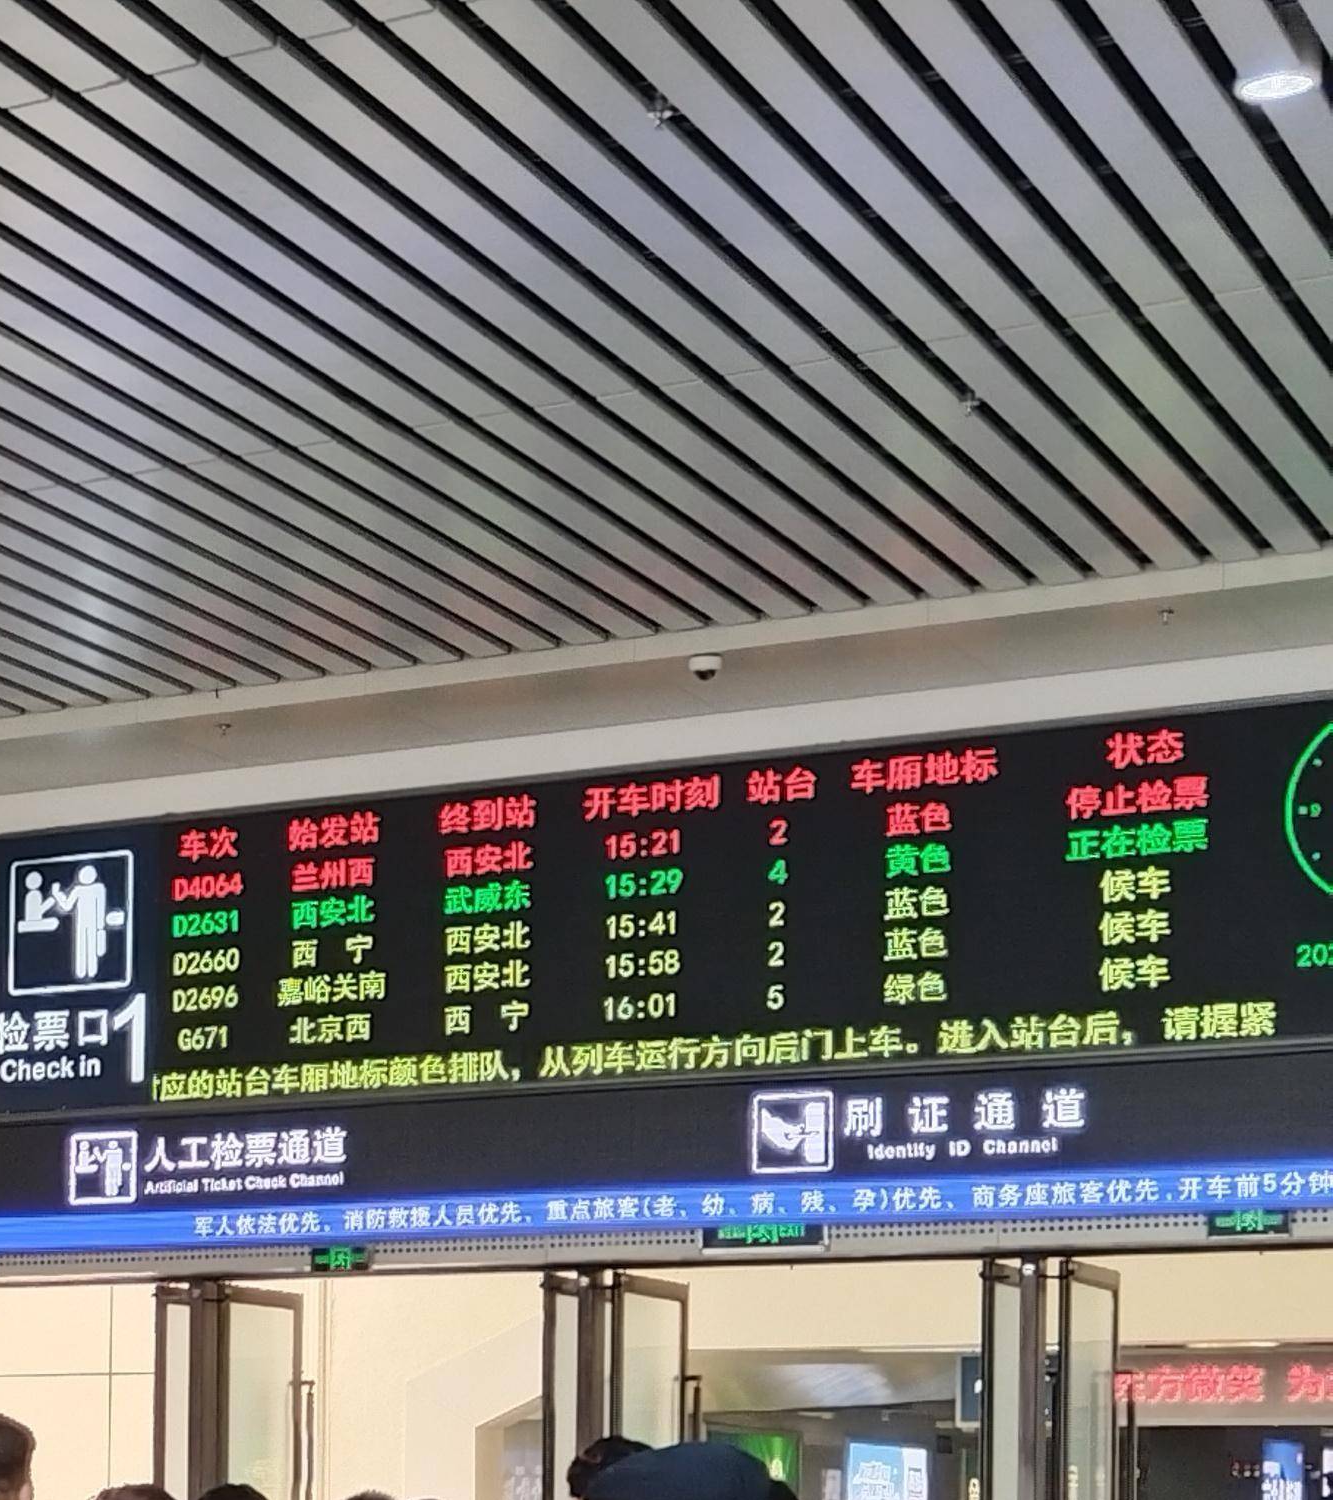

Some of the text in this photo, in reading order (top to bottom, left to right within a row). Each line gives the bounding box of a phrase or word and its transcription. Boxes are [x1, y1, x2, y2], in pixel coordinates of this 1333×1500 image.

[173, 775, 1209, 901] D4064 兰州西 西安北 15:21 2 蓝色 停止检票
[178, 728, 1186, 861] 车次 始发站 终到站 开车时刻 站台 车厢地标 状态
[172, 818, 1209, 937] D2631 西安北 武威东 15:29 4 黄色 正在检票
[173, 948, 240, 976] D2660
[444, 920, 531, 956] 西安北
[606, 910, 677, 940] 15:41
[769, 901, 785, 927] 2
[883, 885, 950, 921] 蓝色
[1098, 865, 1171, 904] 候车
[172, 908, 1171, 1012] D2696 嘉峪关南 西安北 15:58 2 蓝色 候车
[177, 1025, 228, 1051] G671
[289, 1013, 371, 1044] 北京西
[604, 992, 676, 1022] 16:01
[766, 984, 784, 1010] 5
[883, 971, 948, 1005] 绿色
[1098, 953, 1171, 992] 候车
[0, 1055, 101, 1083] Check in
[144, 1126, 348, 1173] 人工检票通道
[202, 1176, 243, 1192] Ticket
[244, 1174, 287, 1190] Check
[289, 1171, 345, 1188] Channel
[868, 1137, 1059, 1162] Identify ID Channel
[1287, 1362, 1333, 1403] 为
